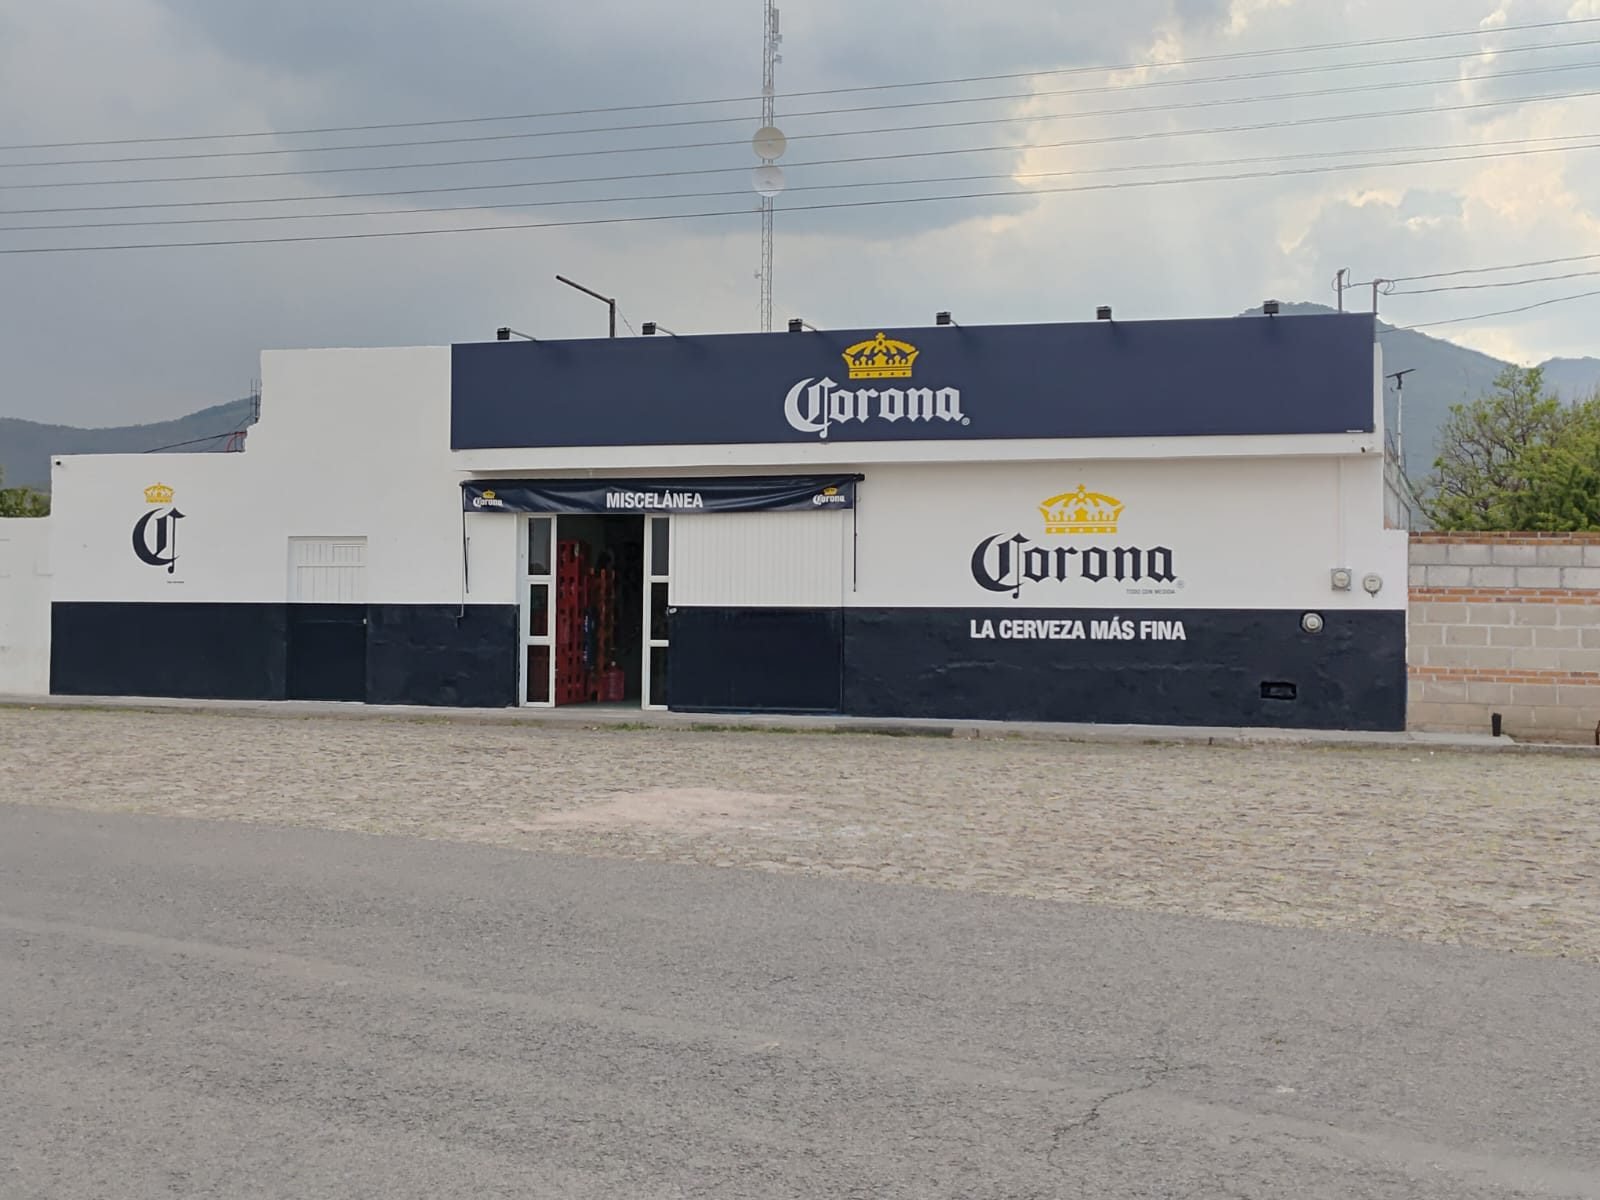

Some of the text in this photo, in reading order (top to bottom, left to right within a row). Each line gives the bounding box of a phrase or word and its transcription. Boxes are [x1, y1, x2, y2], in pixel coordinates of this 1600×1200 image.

[784, 376, 965, 439] Corona
[472, 496, 504, 508] Corona
[606, 489, 704, 509] MISCELÁNEA
[812, 494, 846, 506] Corona
[971, 532, 1178, 599] Corona
[970, 616, 1187, 641] LA CERVEZA MÁS FINA
